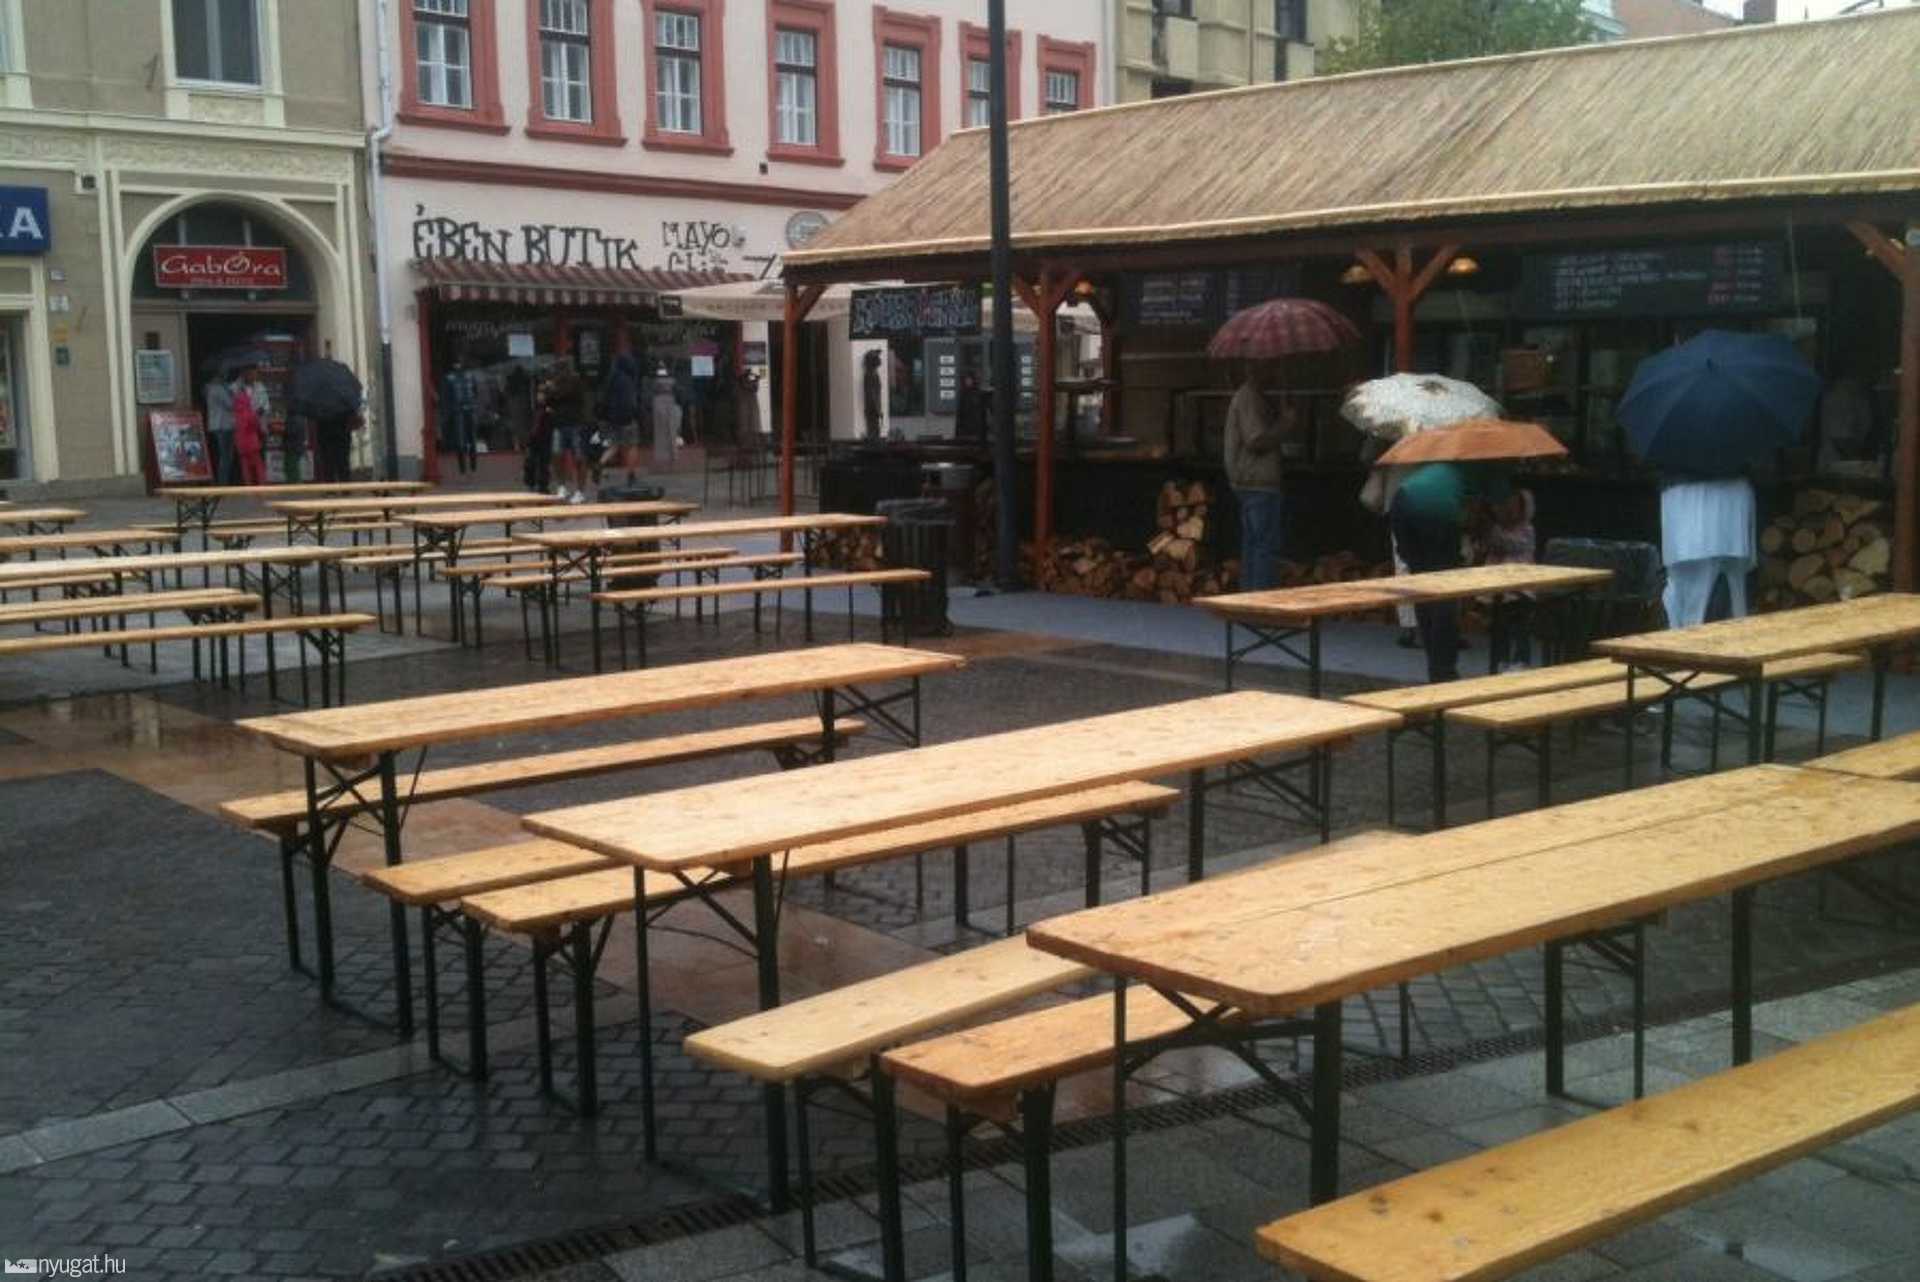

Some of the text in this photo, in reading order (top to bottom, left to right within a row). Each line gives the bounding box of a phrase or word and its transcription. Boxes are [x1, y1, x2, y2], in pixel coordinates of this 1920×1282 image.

[0, 206, 43, 240] A
[413, 204, 641, 270] ÉBEN BUTIK
[661, 221, 730, 256] MAYO
